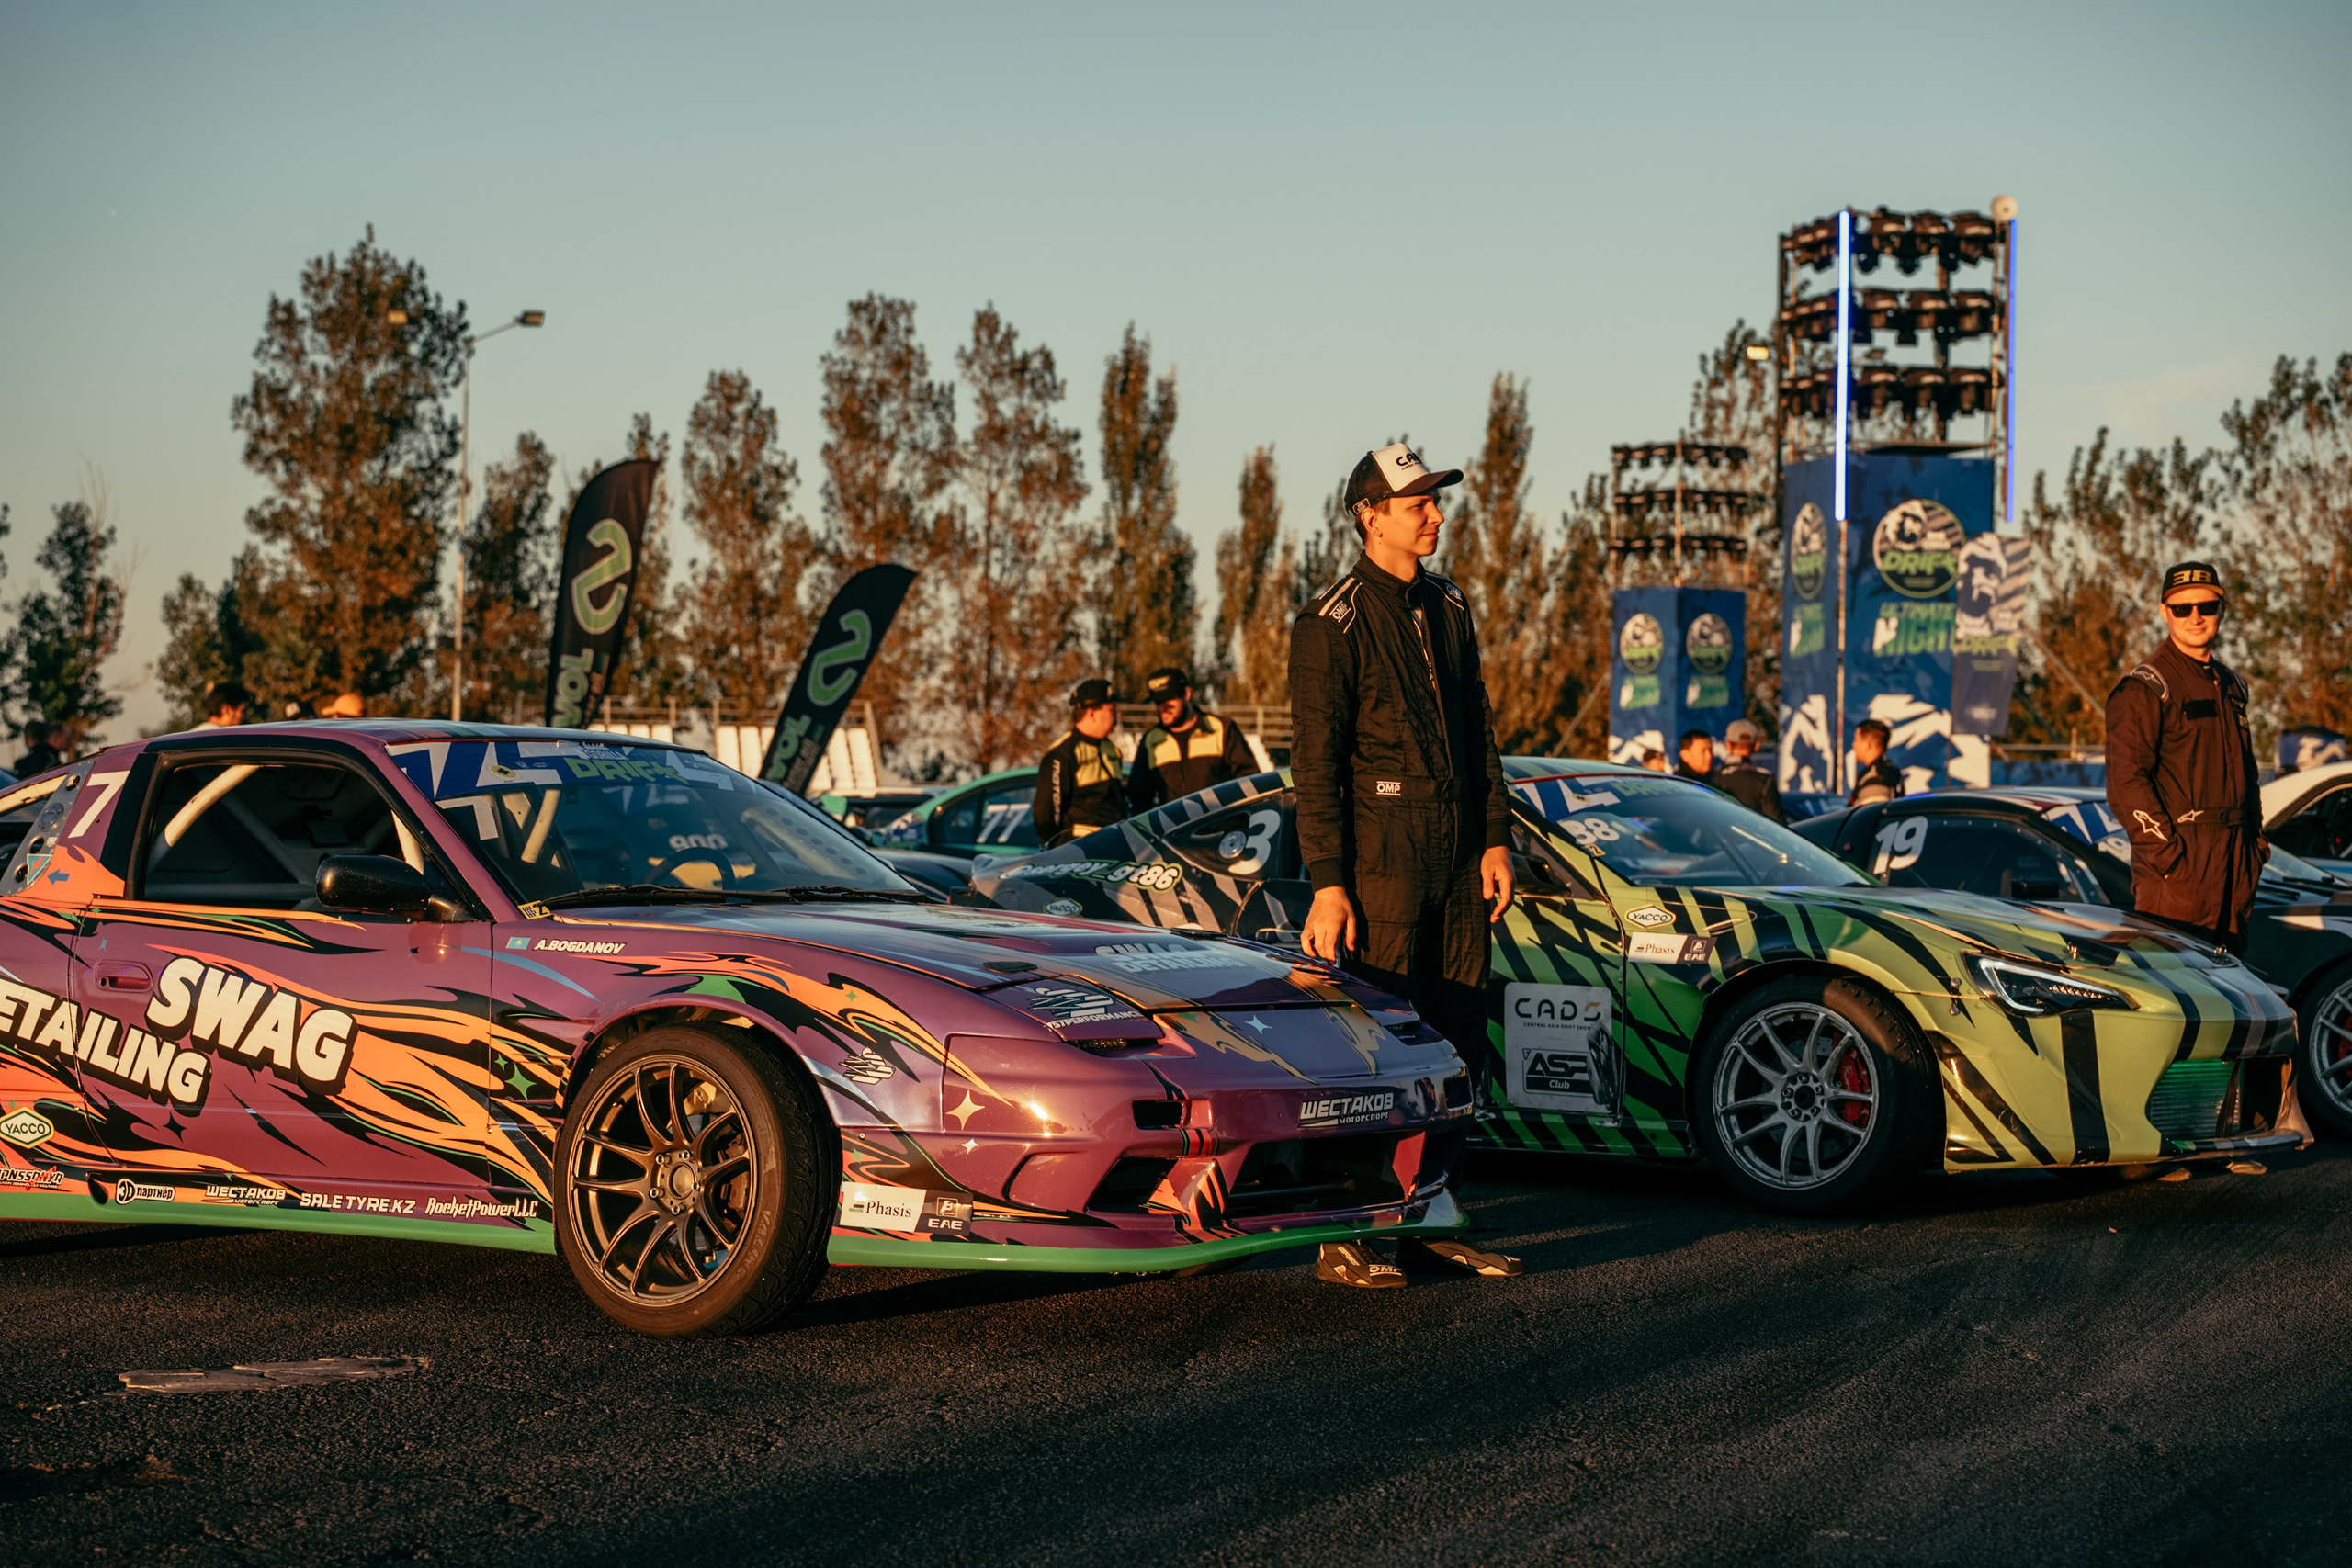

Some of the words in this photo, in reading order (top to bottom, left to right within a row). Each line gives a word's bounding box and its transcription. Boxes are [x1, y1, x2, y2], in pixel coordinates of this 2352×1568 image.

[1883, 551, 1957, 576] DRIFT
[1332, 603, 1348, 619] OMP
[563, 757, 690, 784] DRIFT
[1376, 782, 1401, 794] OMP
[68, 771, 130, 839] 7
[977, 804, 1031, 843] 77
[1557, 818, 1620, 846] 38
[1874, 816, 1928, 874] 19
[1049, 904, 1077, 913] YACCO
[1633, 913, 1668, 922] YACCO
[534, 939, 625, 954] A.BOGDANOV
[1645, 943, 1676, 954] Phasis
[146, 956, 354, 1082] SWAG
[1515, 998, 1601, 1021] CADS
[1526, 1052, 1589, 1078] ASP
[1549, 1079, 1570, 1089] Club
[1299, 1092, 1394, 1120] ШЕСТАКОВ
[1340, 1111, 1389, 1124] МОТОРСПОРТ
[6, 1122, 46, 1134] YACCO
[119, 1180, 134, 1202] 3D
[137, 1187, 173, 1199] партнёр
[206, 1185, 286, 1200] ШЕСТАКОВ
[424, 1195, 538, 1218] RocketPowerLLC
[865, 1200, 911, 1218] Phasis
[928, 1218, 963, 1230] EAE
